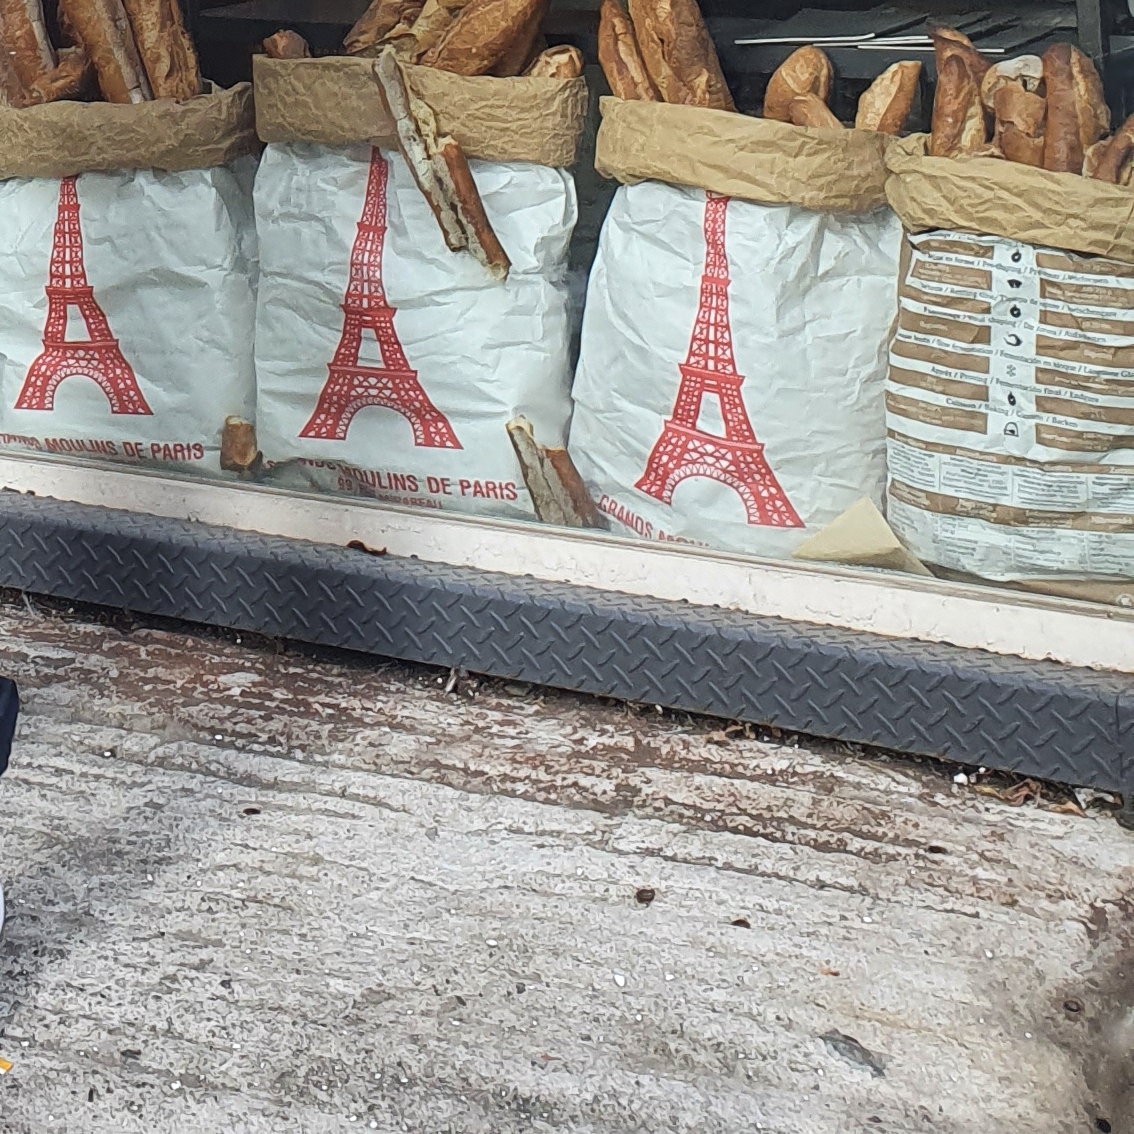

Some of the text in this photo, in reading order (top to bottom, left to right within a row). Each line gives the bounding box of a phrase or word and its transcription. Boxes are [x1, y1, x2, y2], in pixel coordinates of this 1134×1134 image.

[44, 437, 118, 456] MOULINS
[122, 441, 149, 460] DE
[151, 442, 205, 462] PARIS
[426, 476, 453, 495] DE
[459, 478, 519, 501] PARIS
[598, 494, 654, 539] GRANDS
